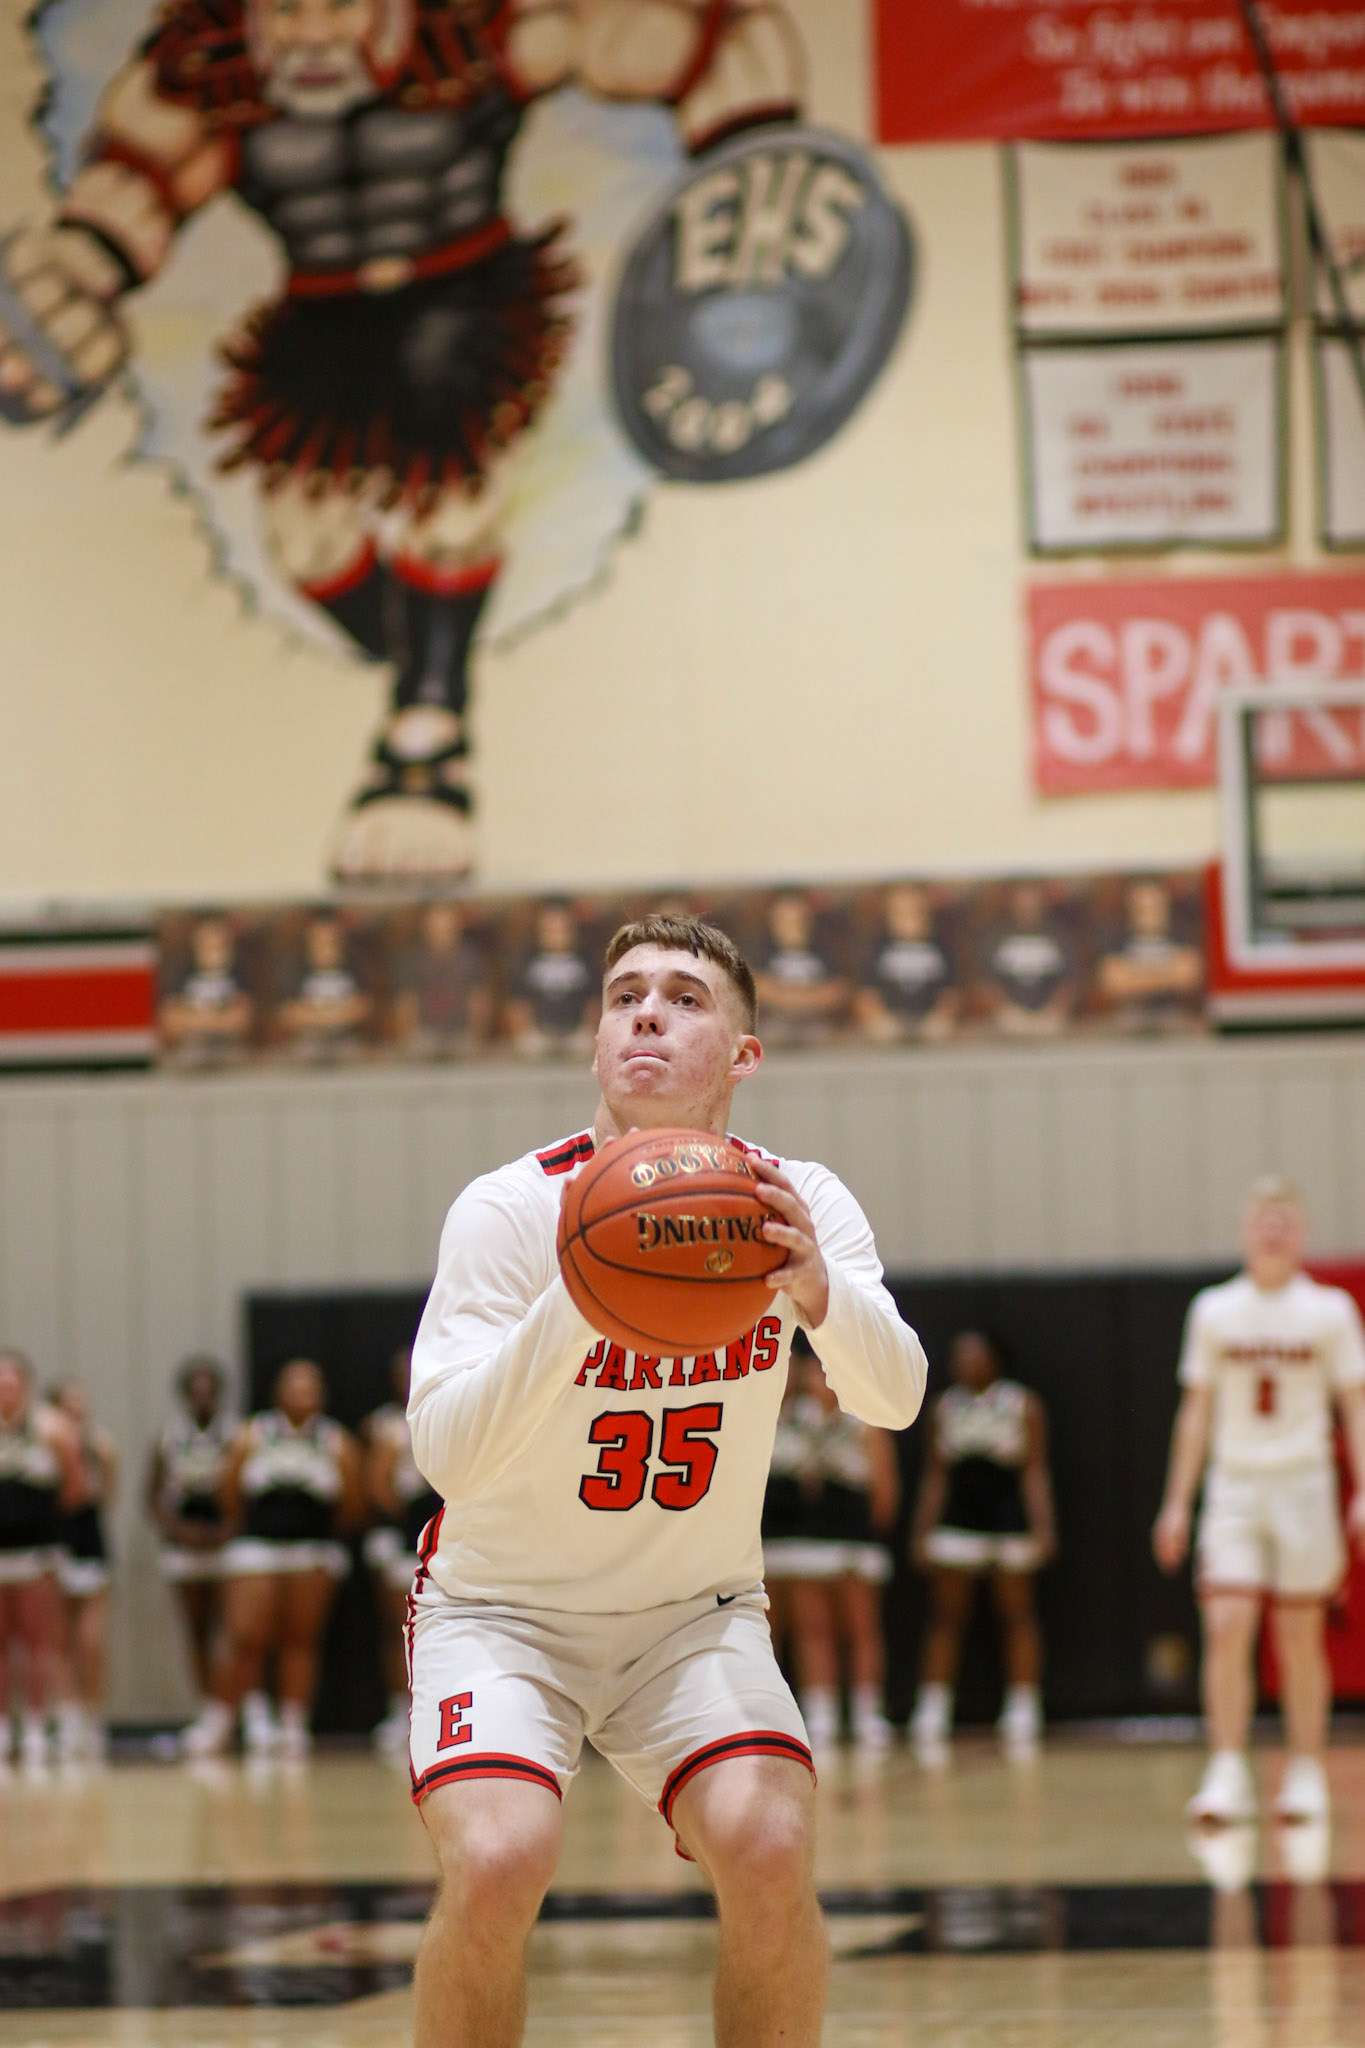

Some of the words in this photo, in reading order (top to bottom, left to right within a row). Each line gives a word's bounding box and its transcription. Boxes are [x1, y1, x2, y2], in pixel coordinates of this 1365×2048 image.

[674, 153, 865, 292] EHS
[578, 1402, 724, 1511] 35
[436, 1690, 473, 1751] E
